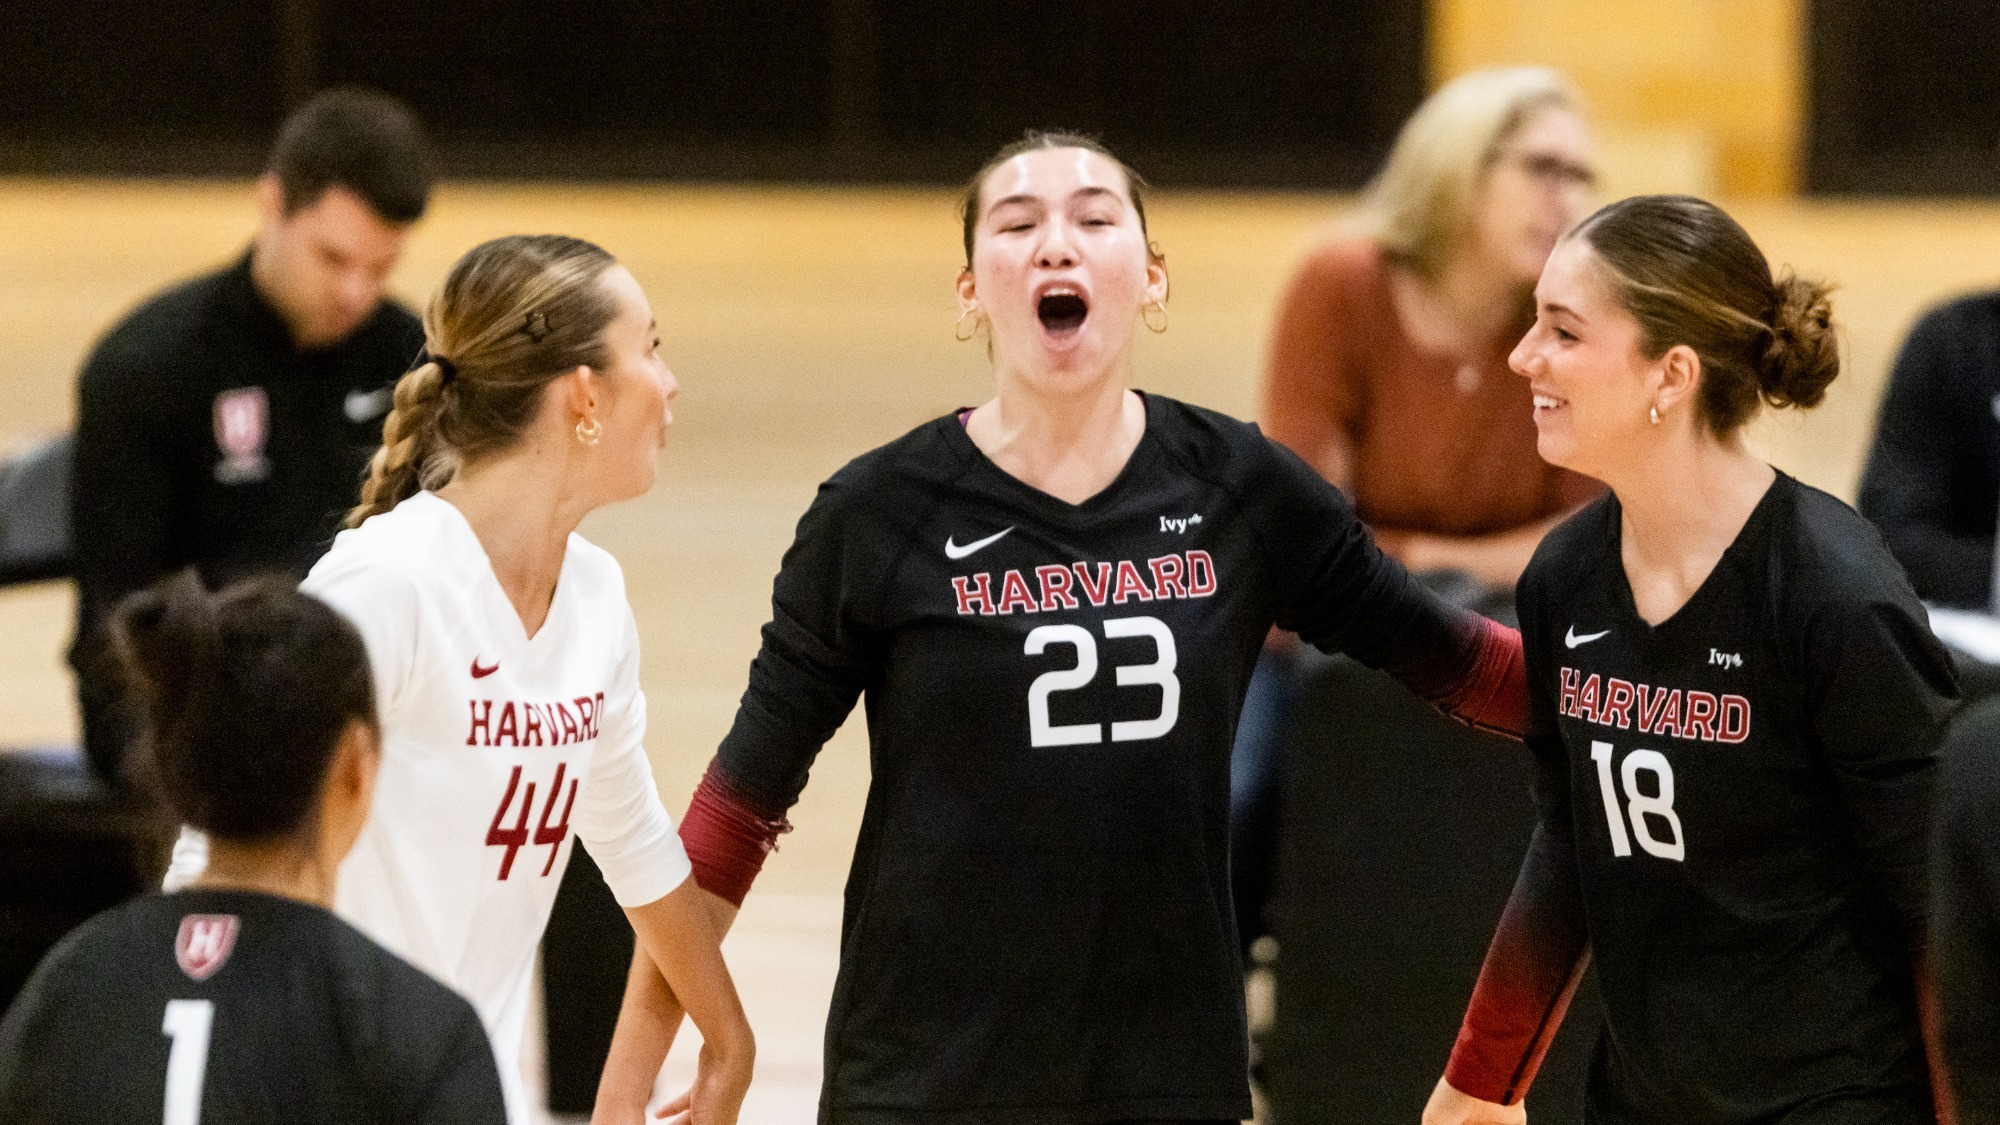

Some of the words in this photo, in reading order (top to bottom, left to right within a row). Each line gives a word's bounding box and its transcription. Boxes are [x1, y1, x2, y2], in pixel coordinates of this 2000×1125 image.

[1159, 515, 1188, 534] Ivy
[952, 550, 1217, 615] HARVARD
[1024, 616, 1180, 748] 23
[1708, 648, 1734, 670] Ivy
[466, 691, 605, 747] HARVARD
[1560, 667, 1751, 744] HARVARD
[485, 762, 579, 881] 44
[1591, 740, 1685, 862] 18
[187, 919, 223, 958] H
[162, 999, 215, 1125] 1
